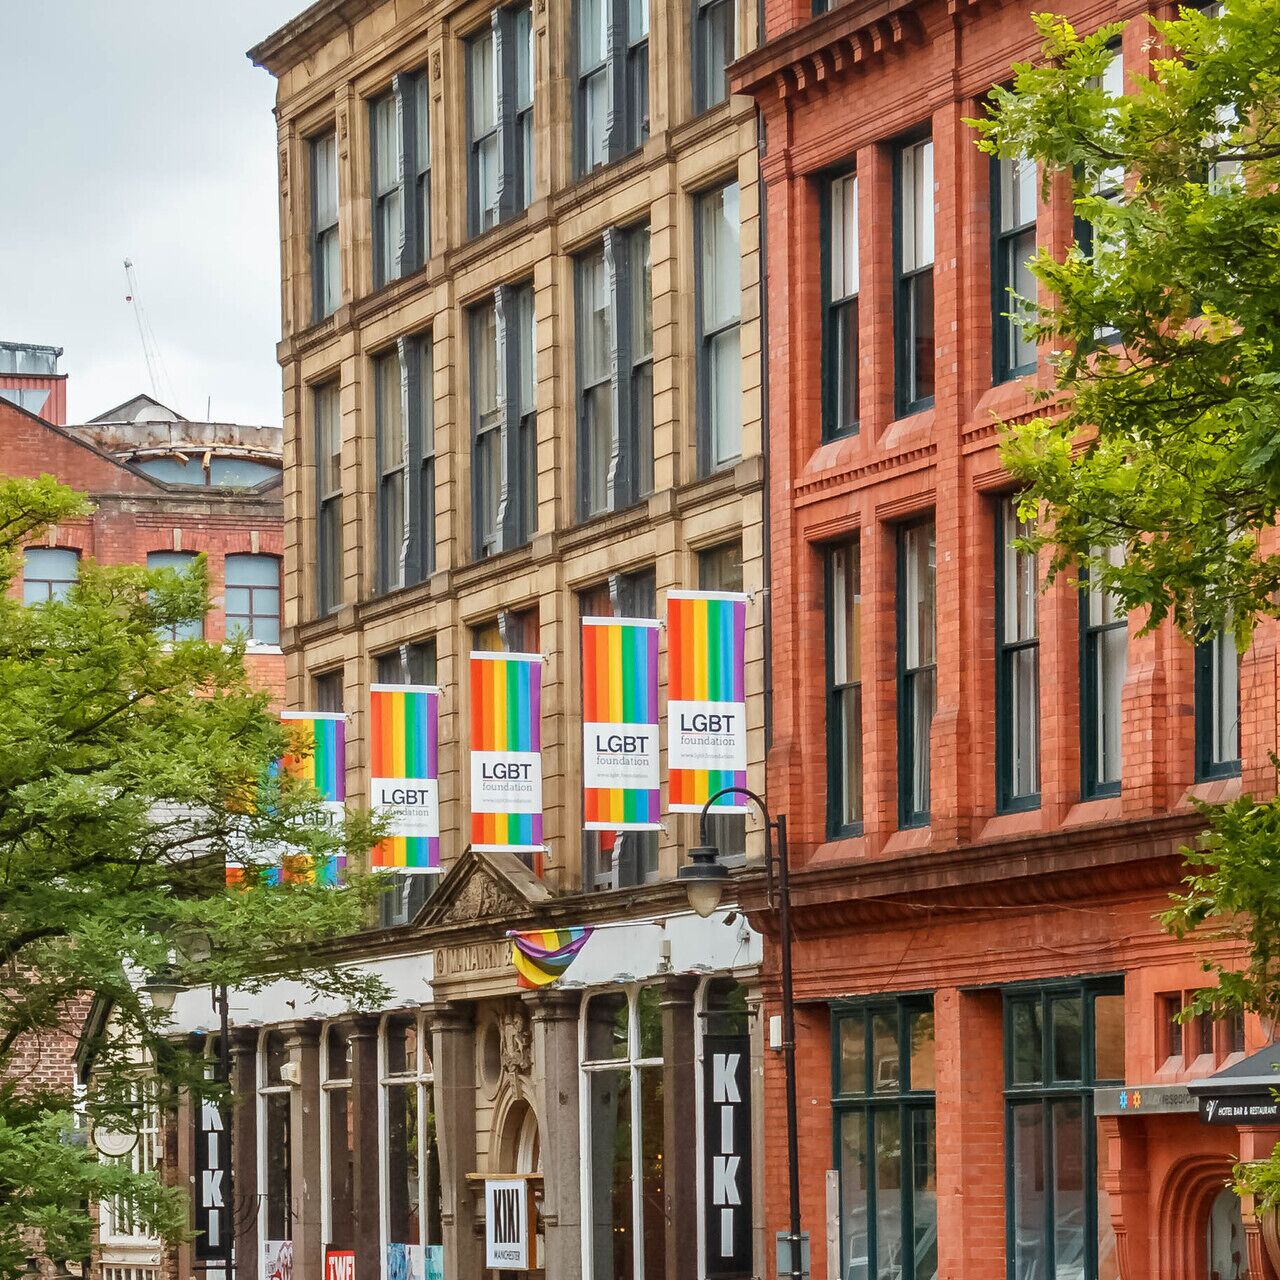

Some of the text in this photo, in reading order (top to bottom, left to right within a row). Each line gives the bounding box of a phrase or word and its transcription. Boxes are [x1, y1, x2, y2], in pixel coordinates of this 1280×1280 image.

[680, 713, 735, 733] LGBT
[596, 735, 650, 753] LGBT
[680, 735, 736, 746] foundation
[596, 756, 650, 766] foundation
[482, 762, 532, 780] LGBT
[482, 782, 533, 792] foundation
[381, 789, 429, 806] LGBT
[1218, 1106, 1233, 1116] HOTEL
[1233, 1106, 1243, 1115] BAR
[1244, 1106, 1248, 1115] &
[1249, 1105, 1278, 1115] RESTAURANT
[713, 1053, 742, 1258] KIKI
[201, 1095, 225, 1247] KIKI
[493, 1188, 520, 1243] KIKI
